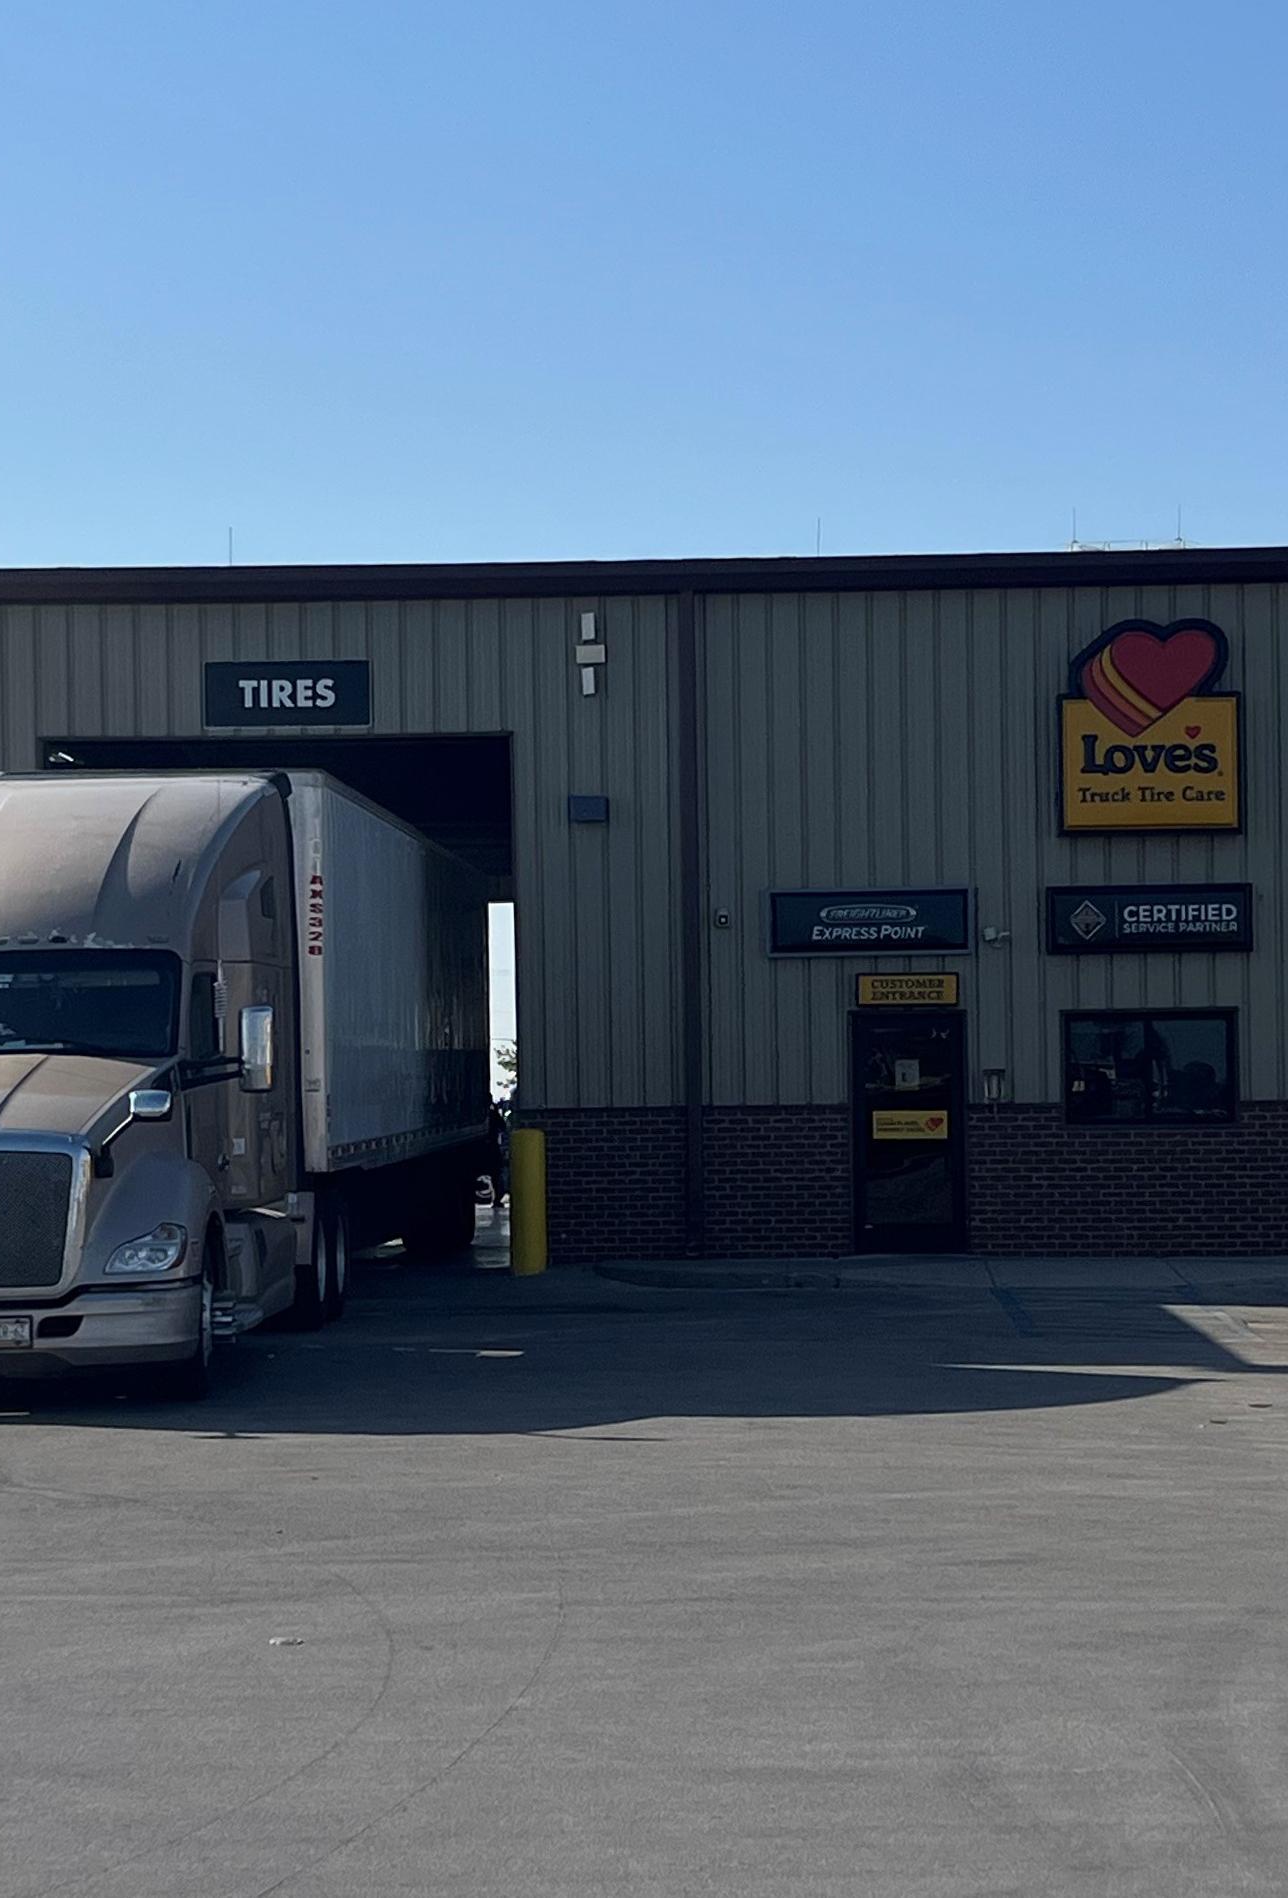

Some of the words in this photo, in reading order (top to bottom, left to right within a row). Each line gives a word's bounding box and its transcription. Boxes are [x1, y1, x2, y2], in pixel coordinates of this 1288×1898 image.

[238, 678, 336, 708] TIRES
[1078, 786, 1131, 803] Truck
[1137, 786, 1175, 802] Tire
[1182, 786, 1226, 803] Care
[1123, 904, 1238, 922] CERTIFIED
[812, 926, 877, 940] EXPRESS
[880, 925, 926, 940] POINT
[1123, 922, 1176, 934] SERVICE
[1179, 921, 1238, 933] PARTNER
[871, 979, 945, 989] CUSTOMER
[870, 990, 945, 1001] ENTRANCE
